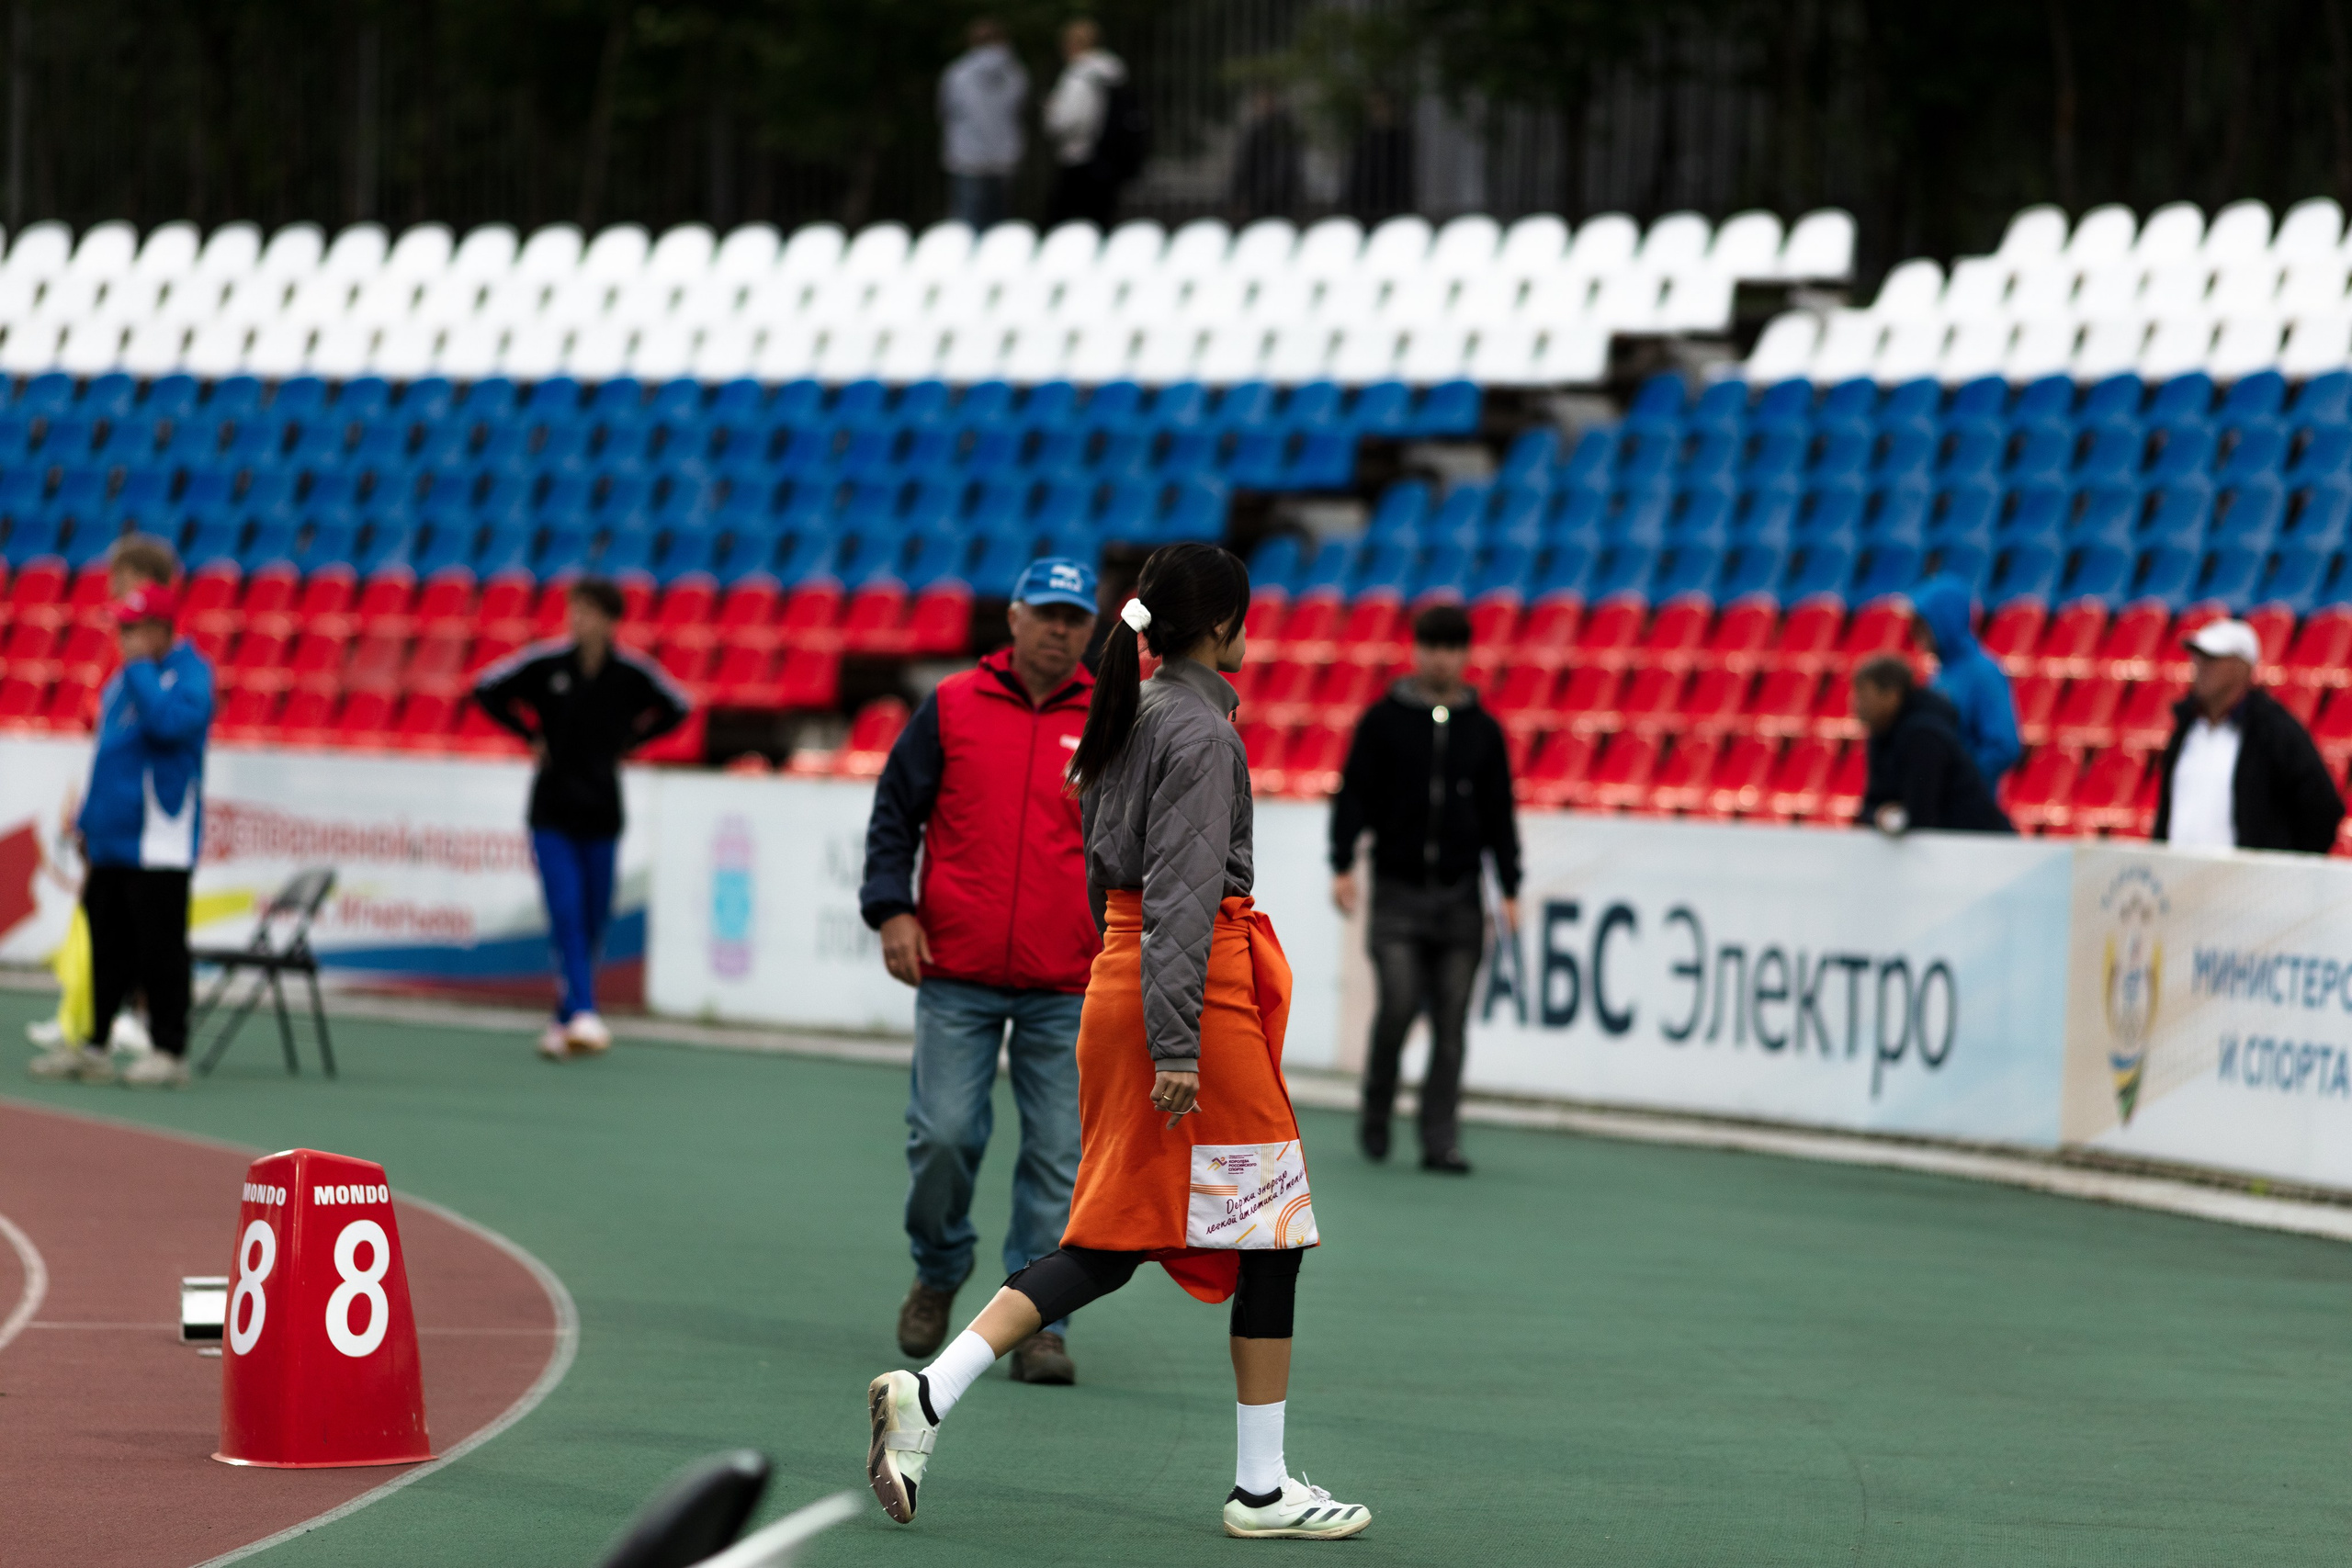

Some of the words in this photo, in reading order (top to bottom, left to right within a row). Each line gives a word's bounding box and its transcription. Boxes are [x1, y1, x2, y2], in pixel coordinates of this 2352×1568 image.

[1481, 898, 1640, 1039] АБС
[1661, 904, 1958, 1099] Электро
[2243, 1036, 2351, 1099] СПОРТА
[242, 1182, 287, 1206] MONDO
[313, 1184, 389, 1205] MONDO
[230, 1220, 276, 1356] 8
[325, 1220, 390, 1358] 8
